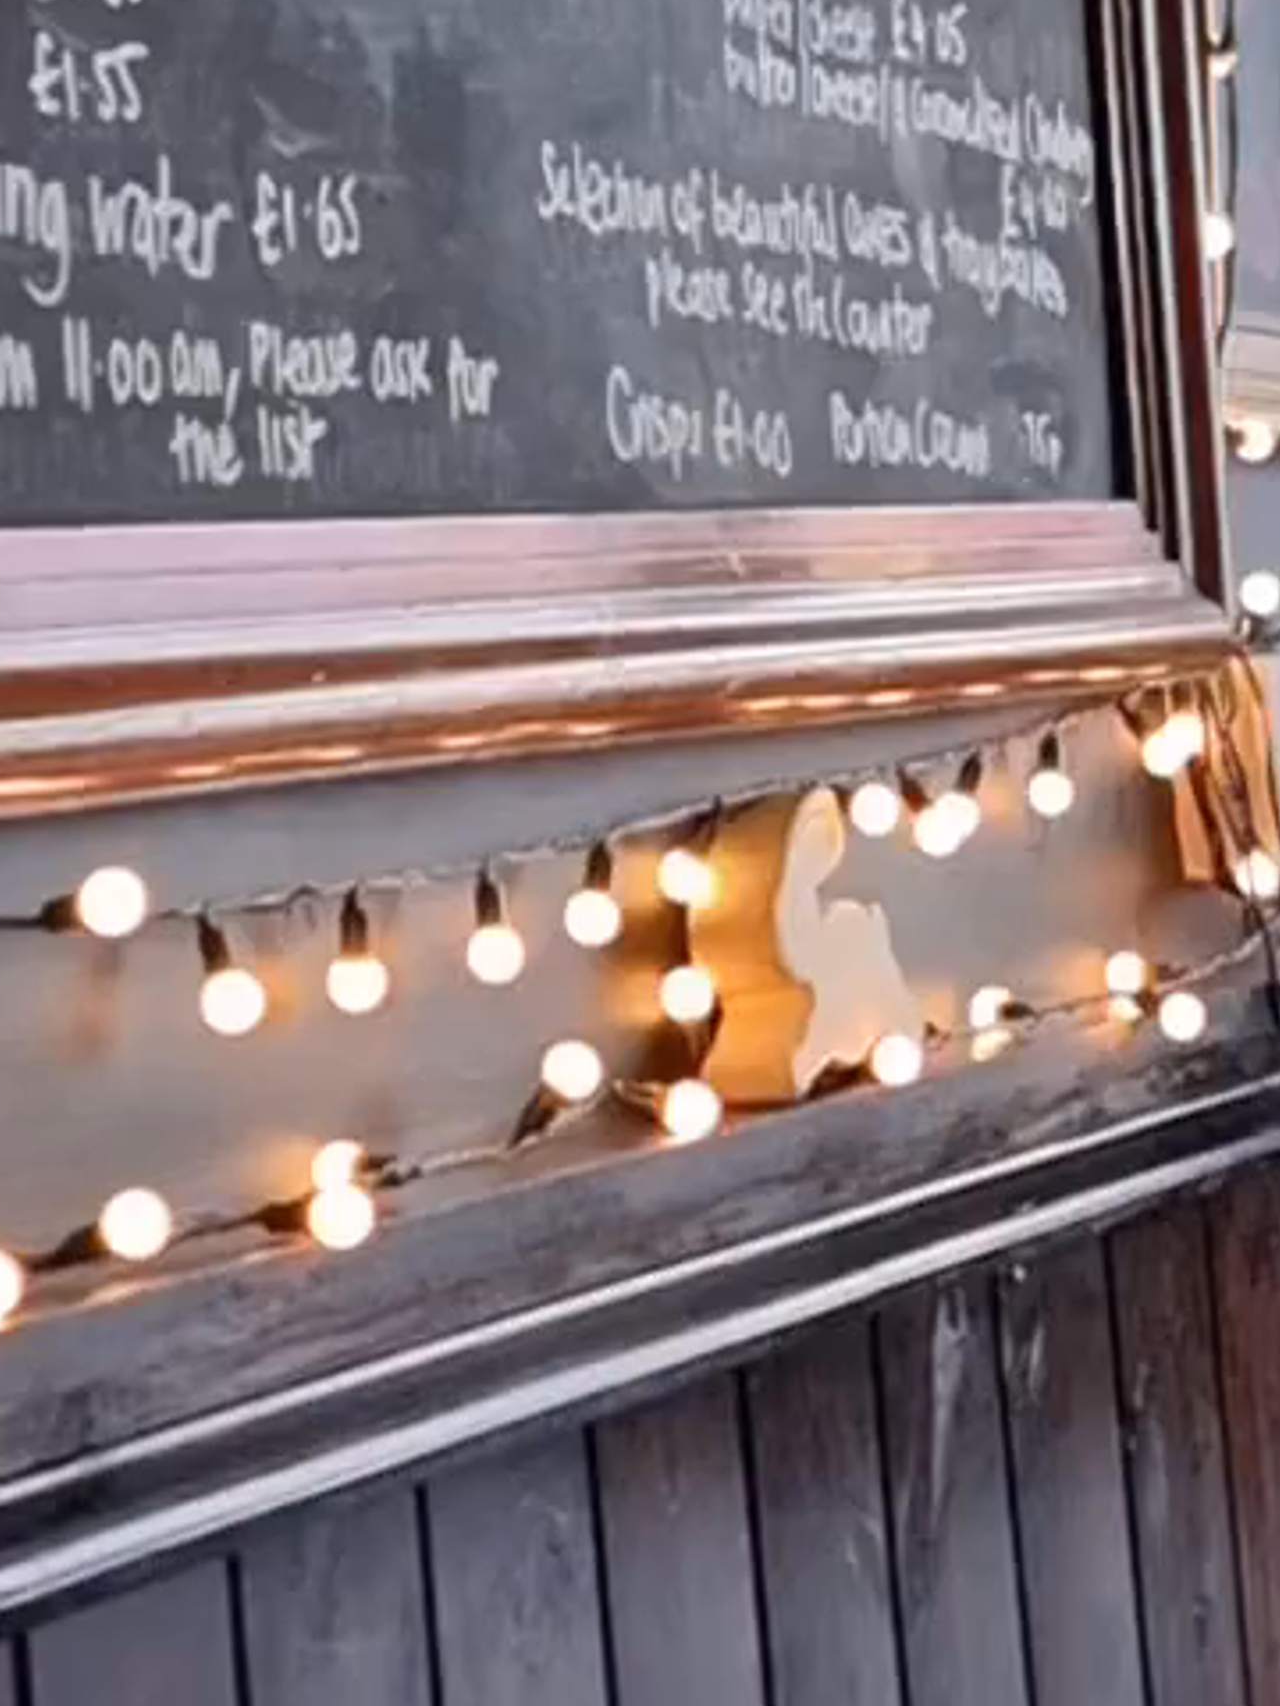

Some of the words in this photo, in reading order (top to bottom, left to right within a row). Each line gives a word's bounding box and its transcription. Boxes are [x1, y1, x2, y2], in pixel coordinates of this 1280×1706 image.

[27, 31, 148, 122] £1.55
[88, 155, 233, 279] water
[251, 171, 361, 265] £1.65
[248, 321, 360, 395] Please
[446, 335, 499, 421] for
[168, 414, 244, 485] the
[256, 406, 327, 480] list
